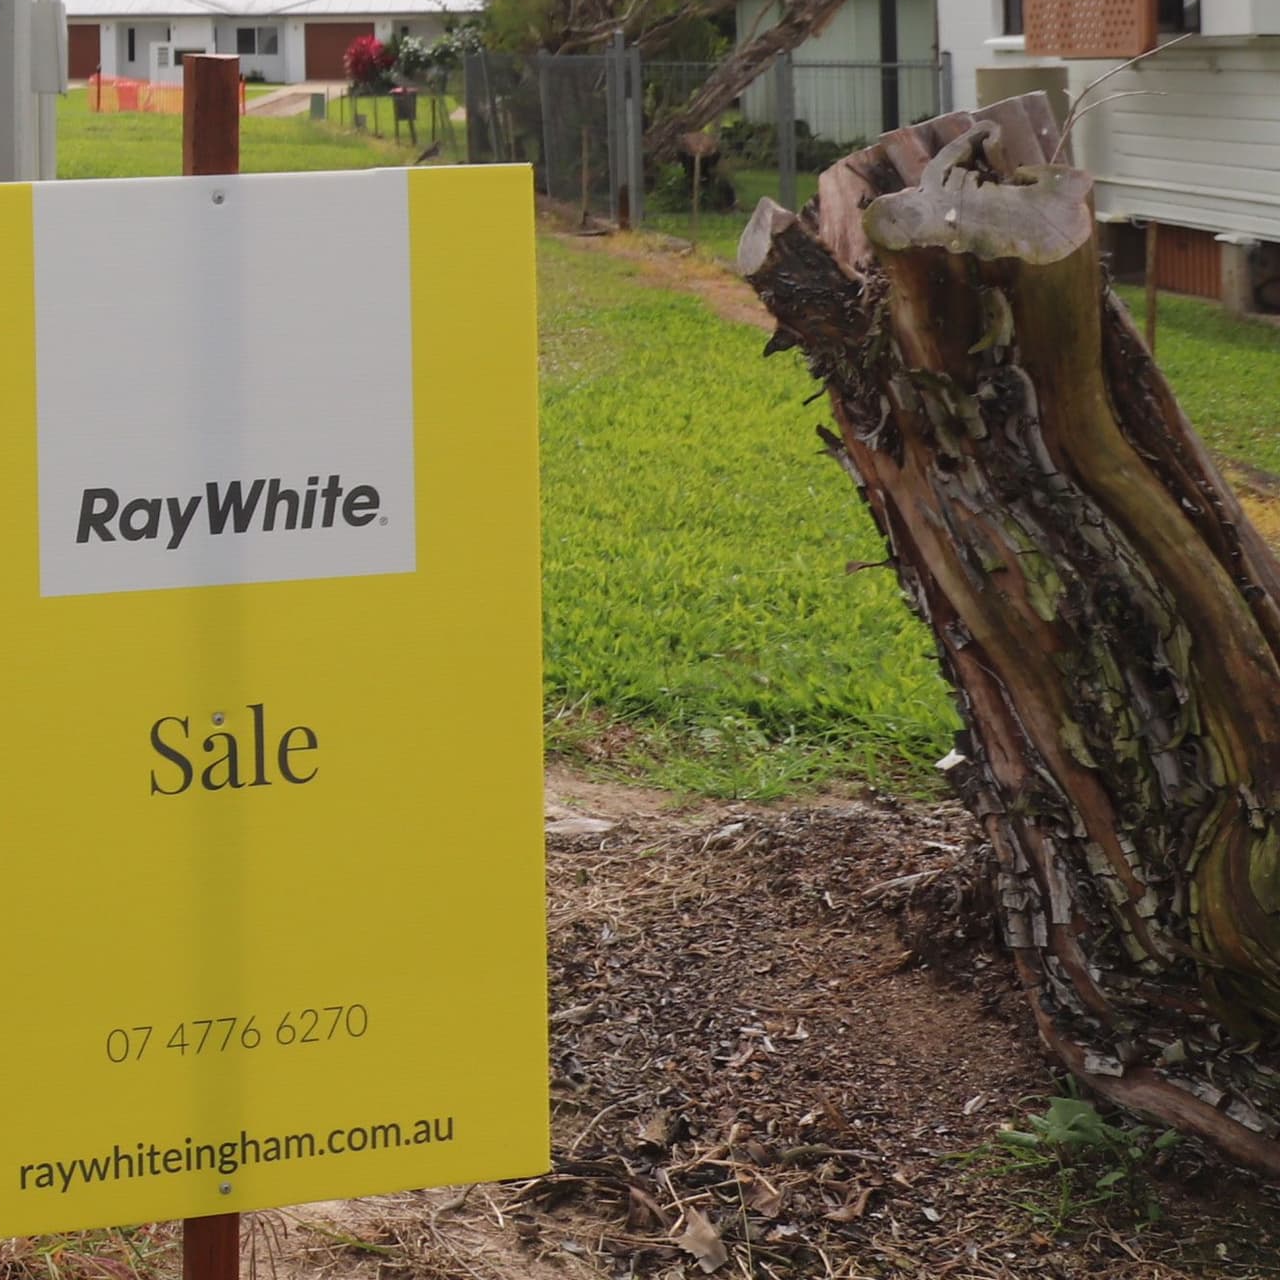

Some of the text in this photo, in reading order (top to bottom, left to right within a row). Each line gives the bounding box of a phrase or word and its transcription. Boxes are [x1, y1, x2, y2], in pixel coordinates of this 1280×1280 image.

[149, 703, 320, 798] Sale
[105, 1003, 369, 1064] 07 4776 6270
[19, 1116, 454, 1194] raywhiteingham.com.au
